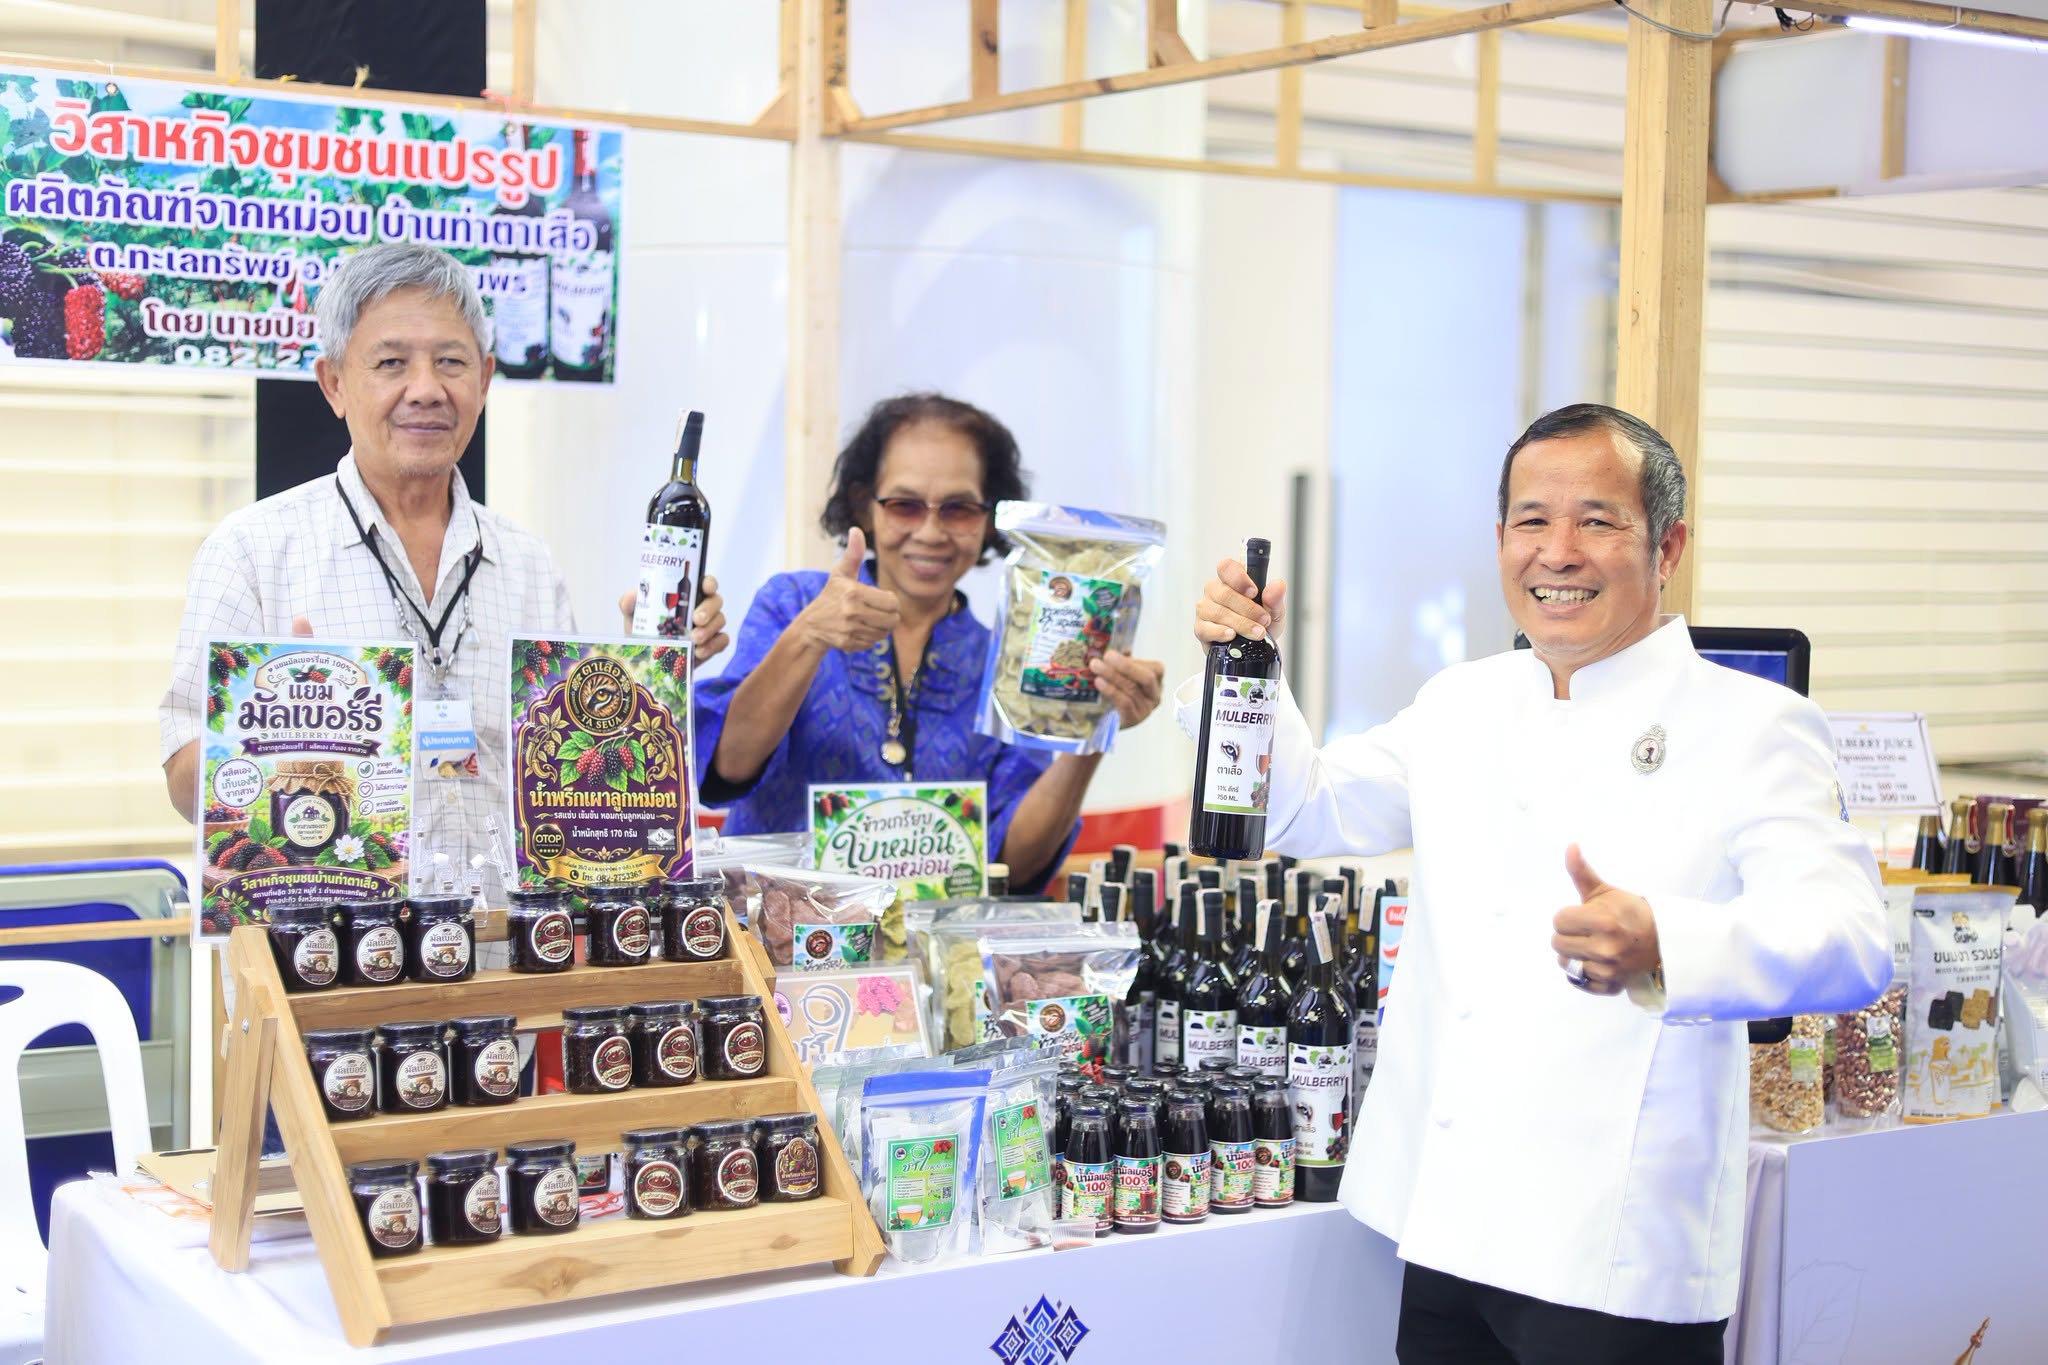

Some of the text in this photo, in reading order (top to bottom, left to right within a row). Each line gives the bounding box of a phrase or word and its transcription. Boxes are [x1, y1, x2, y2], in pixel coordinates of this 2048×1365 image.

[51, 99, 560, 202] วิสาหกิจชุมชนแปรรูป
[7, 175, 597, 254] ผลิตภัณฑ์จากหม่อน บ้านท่าตาเสือ
[94, 244, 292, 280] ต.ทะเลทรัพย์
[145, 303, 322, 339] โดย นายปิย
[332, 660, 352, 672] 100%
[581, 660, 621, 677] ตาเสือ
[288, 683, 334, 702] แยม
[582, 714, 593, 727] TA
[596, 716, 623, 729] SEUA
[1215, 709, 1275, 726] MULBERRY
[271, 731, 353, 741] MULBERRY JAM
[1216, 764, 1243, 776] ตาเสือ
[529, 782, 678, 813] น้ำพริกเผาลูกหม่อน
[861, 808, 934, 834] ข้าวเกรียบ
[535, 834, 562, 844] OTOP
[610, 829, 623, 838] 170
[624, 828, 638, 838] กรัม
[831, 823, 957, 869] ใบหม่อน
[861, 856, 951, 880] ลกหม่อน
[241, 870, 380, 892] วิสาหกิจชุมชนบ้านท่าตาเสือ
[1292, 1074, 1346, 1088] MULBERRY
